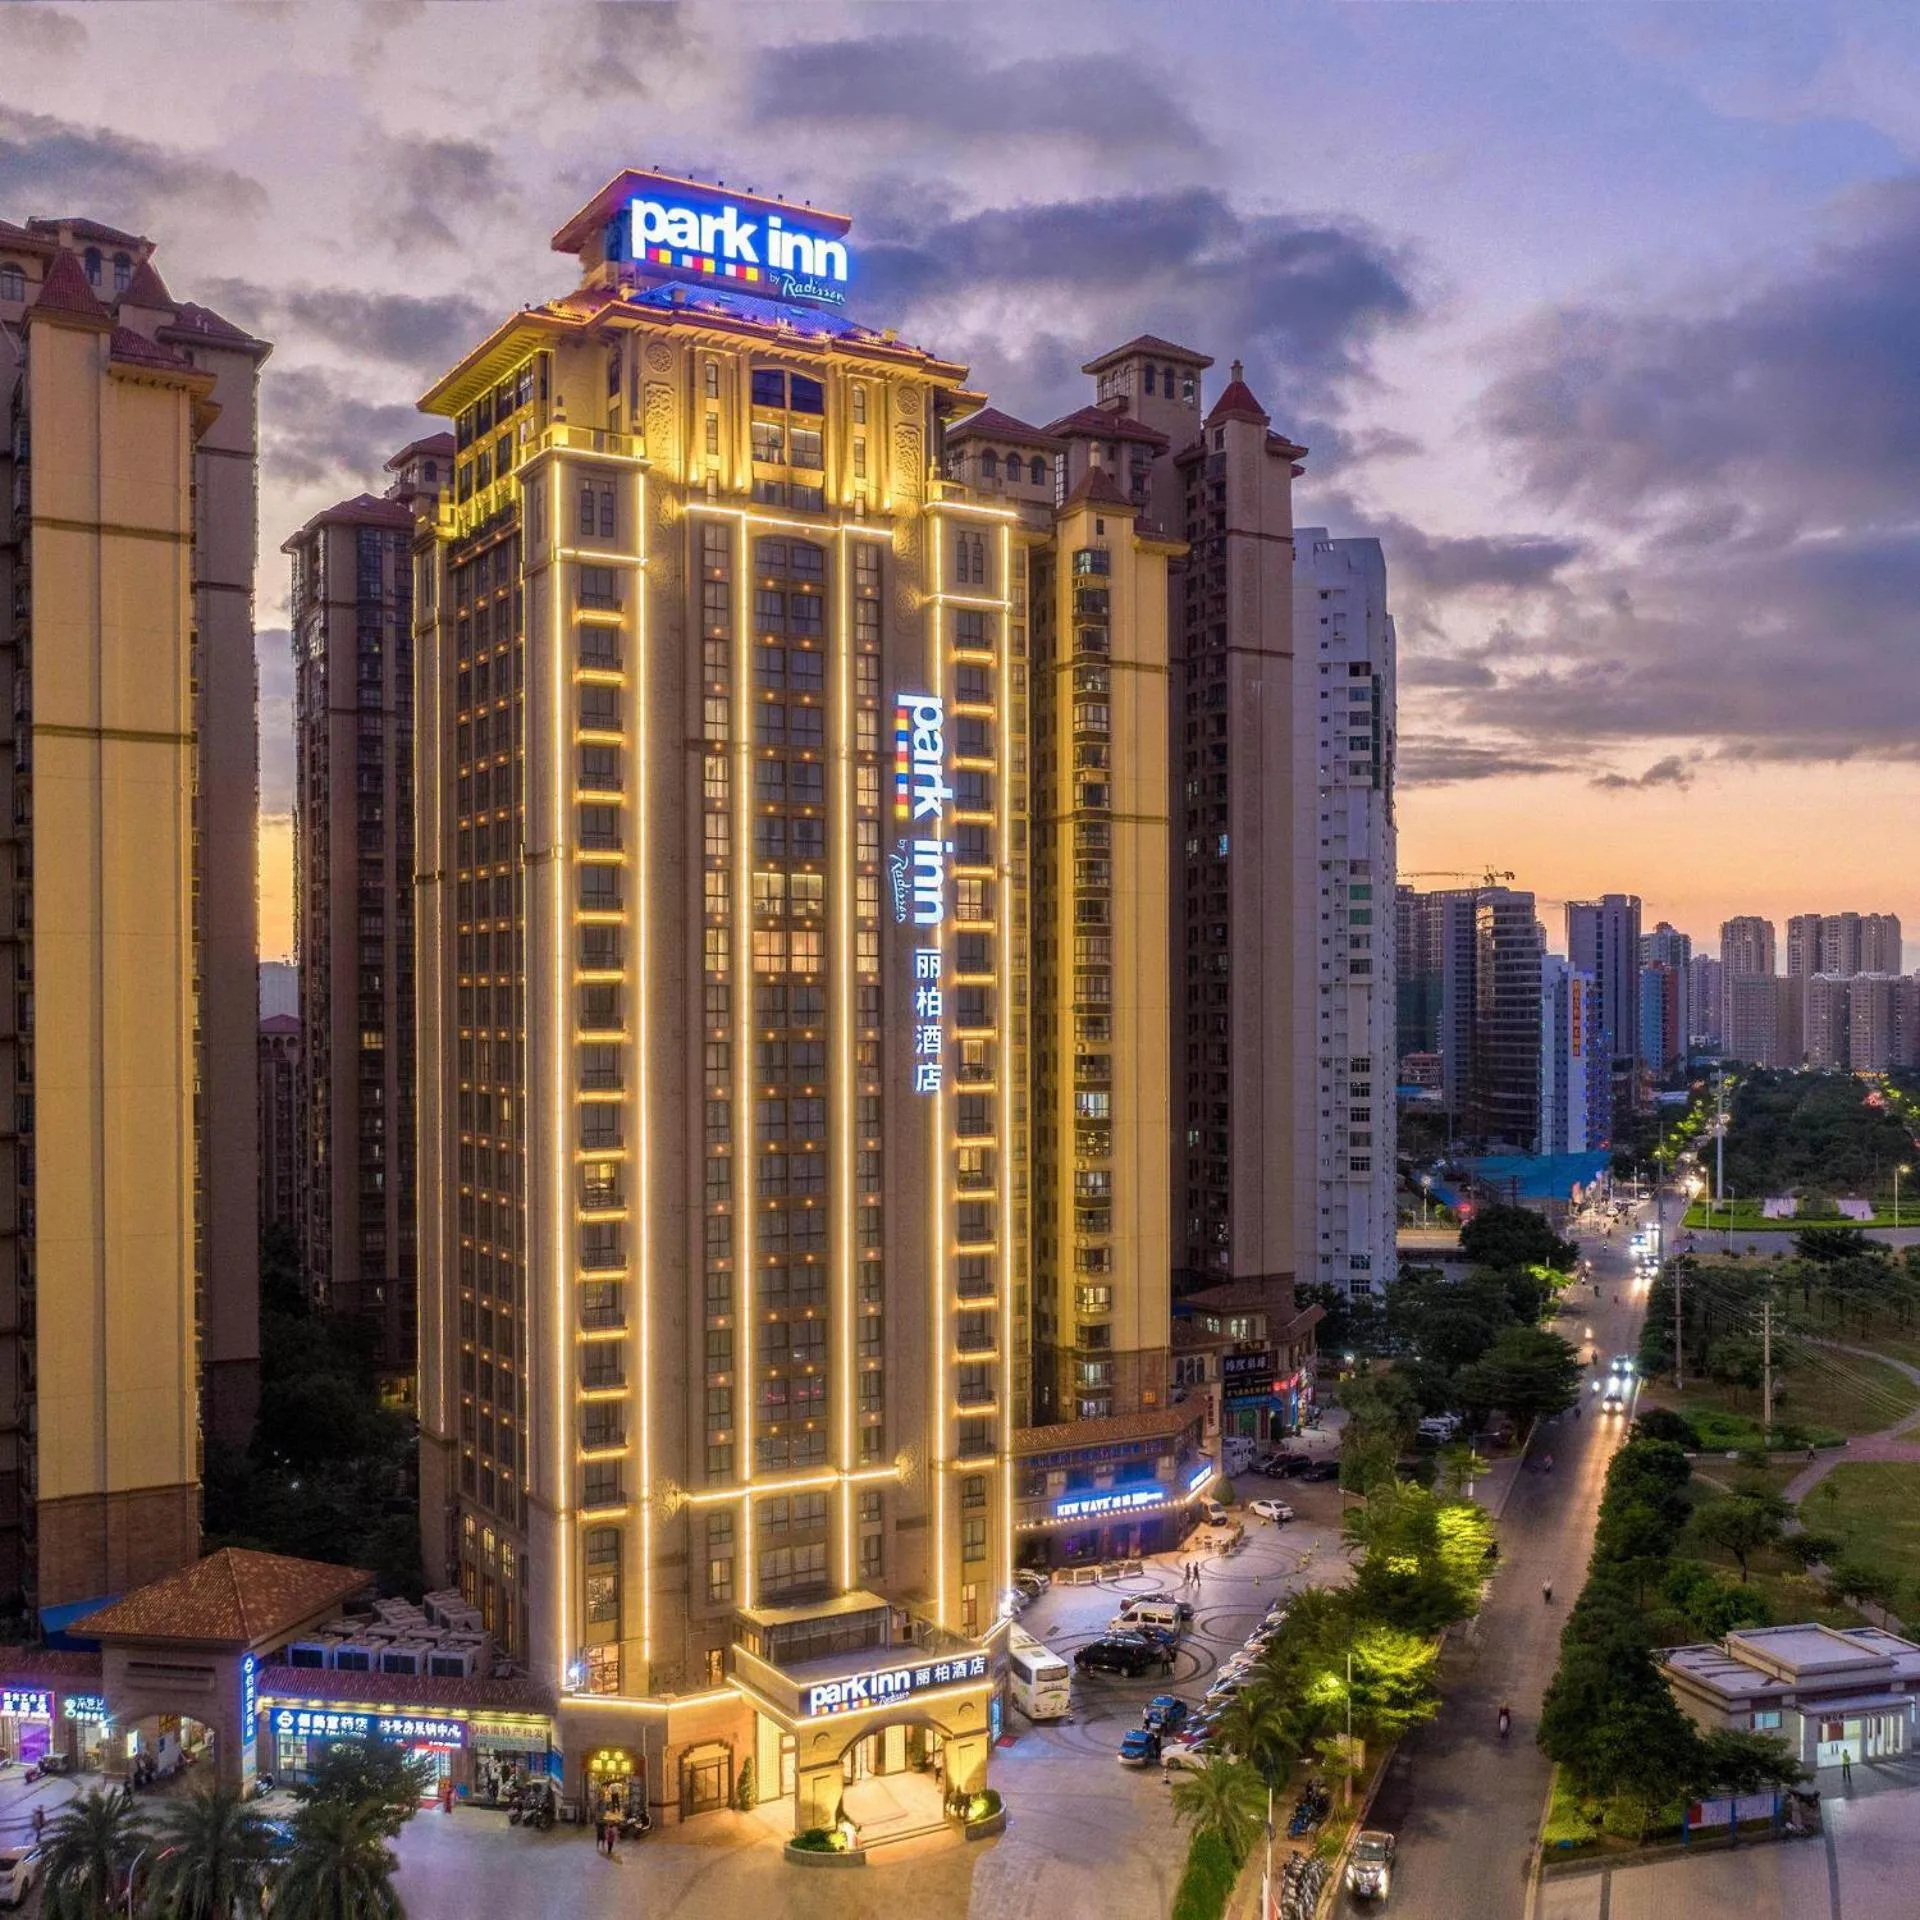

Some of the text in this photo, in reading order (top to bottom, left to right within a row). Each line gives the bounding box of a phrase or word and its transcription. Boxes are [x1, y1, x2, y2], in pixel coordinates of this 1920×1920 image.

[631, 198, 848, 281] park inn
[769, 272, 846, 303] by Radisson
[897, 694, 953, 925] park inn
[915, 947, 943, 1094] 丽柏酒店
[810, 1670, 910, 1716] park inn
[916, 1656, 986, 1686] 丽柏酒店
